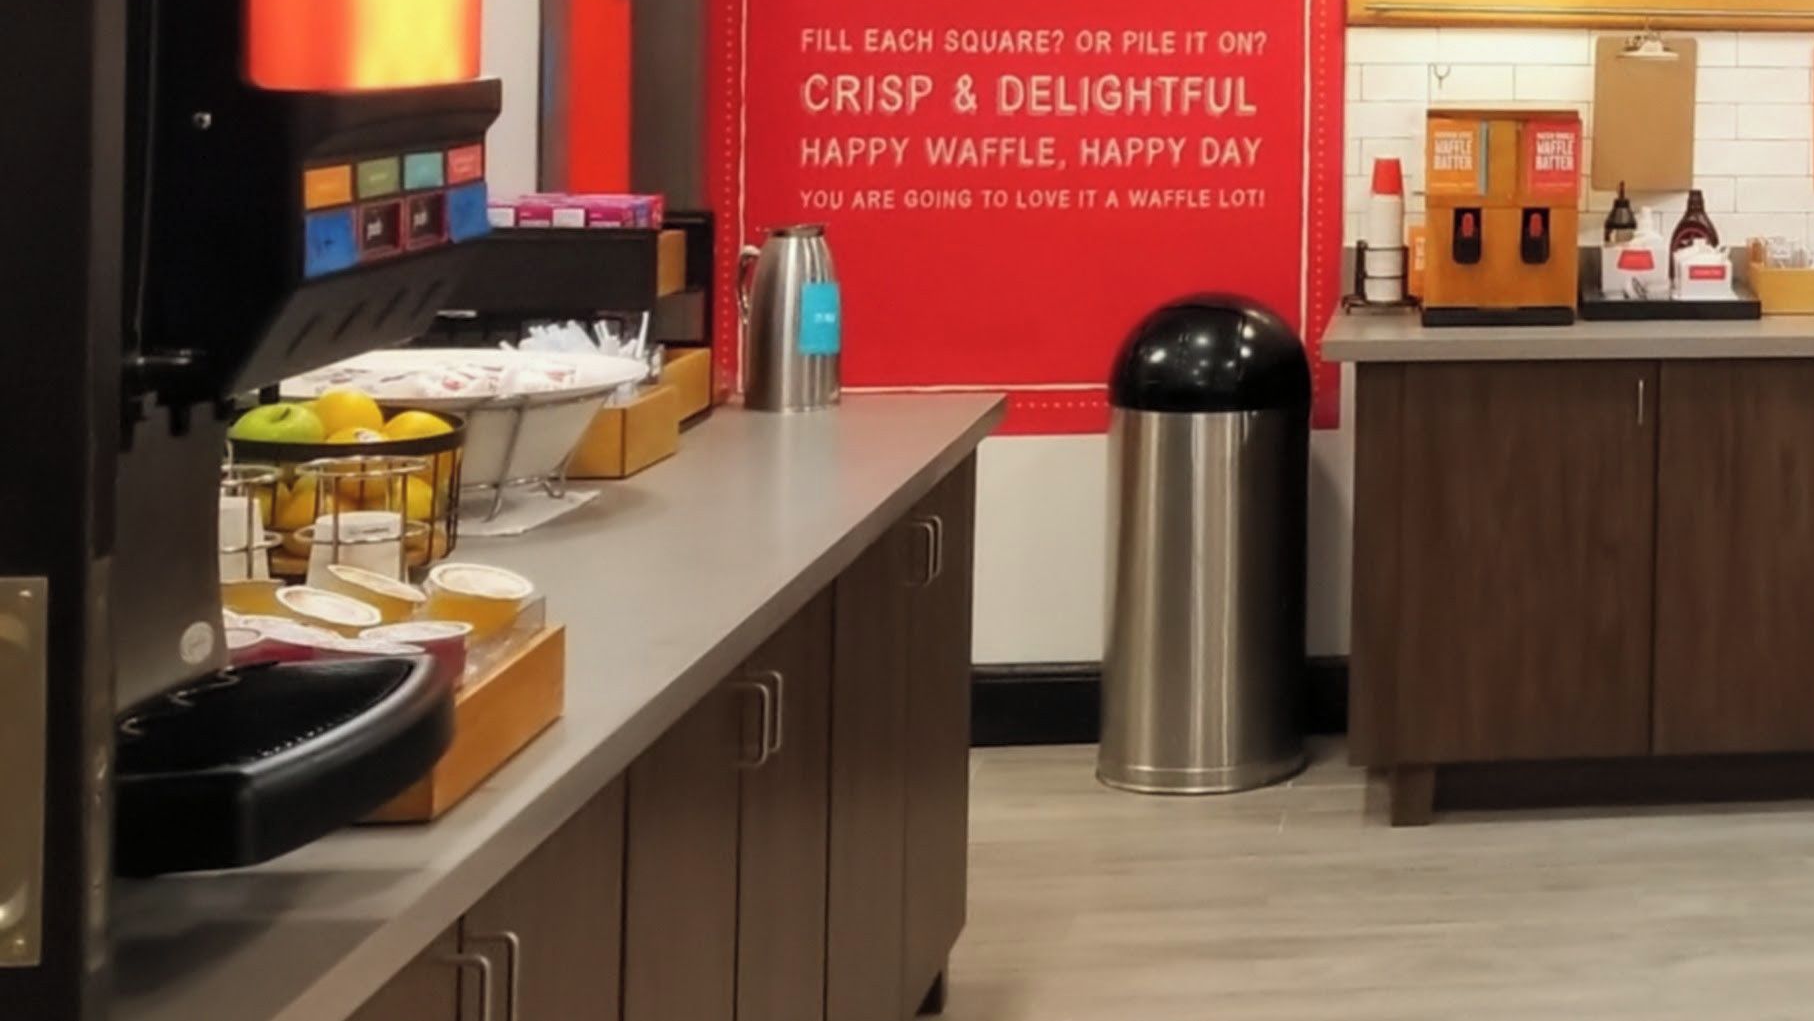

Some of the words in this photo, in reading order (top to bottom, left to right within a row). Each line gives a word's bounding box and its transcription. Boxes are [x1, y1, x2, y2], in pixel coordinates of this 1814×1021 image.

[801, 28, 852, 53] FILL
[864, 28, 933, 53] EACH
[943, 29, 1064, 54] SQUARE?
[1076, 30, 1111, 55] OR
[1122, 30, 1176, 55] PILE
[1185, 31, 1208, 55] IT
[1218, 31, 1267, 56] ON?
[802, 73, 933, 116] CRISP
[953, 73, 978, 115] &
[996, 73, 1257, 117] DELIGHTFUL
[801, 136, 909, 167] HAPPY
[925, 136, 1067, 171] WAFFLE,
[1080, 136, 1187, 168] HAPPY
[1201, 136, 1262, 168] DAY
[1434, 139, 1473, 155] WAFFLE
[1536, 140, 1575, 156] WAFFLE
[1433, 155, 1473, 171] BATTER
[1535, 156, 1574, 172] BATTER
[800, 189, 844, 210] YOU
[851, 189, 896, 210] ARE
[903, 189, 973, 210] GOING
[981, 189, 1008, 210] TO
[1016, 189, 1071, 210] LOVE
[1078, 189, 1097, 209] IT
[1105, 189, 1119, 209] A
[1128, 188, 1211, 209] WAFFLE
[1219, 188, 1266, 209] LOT!
